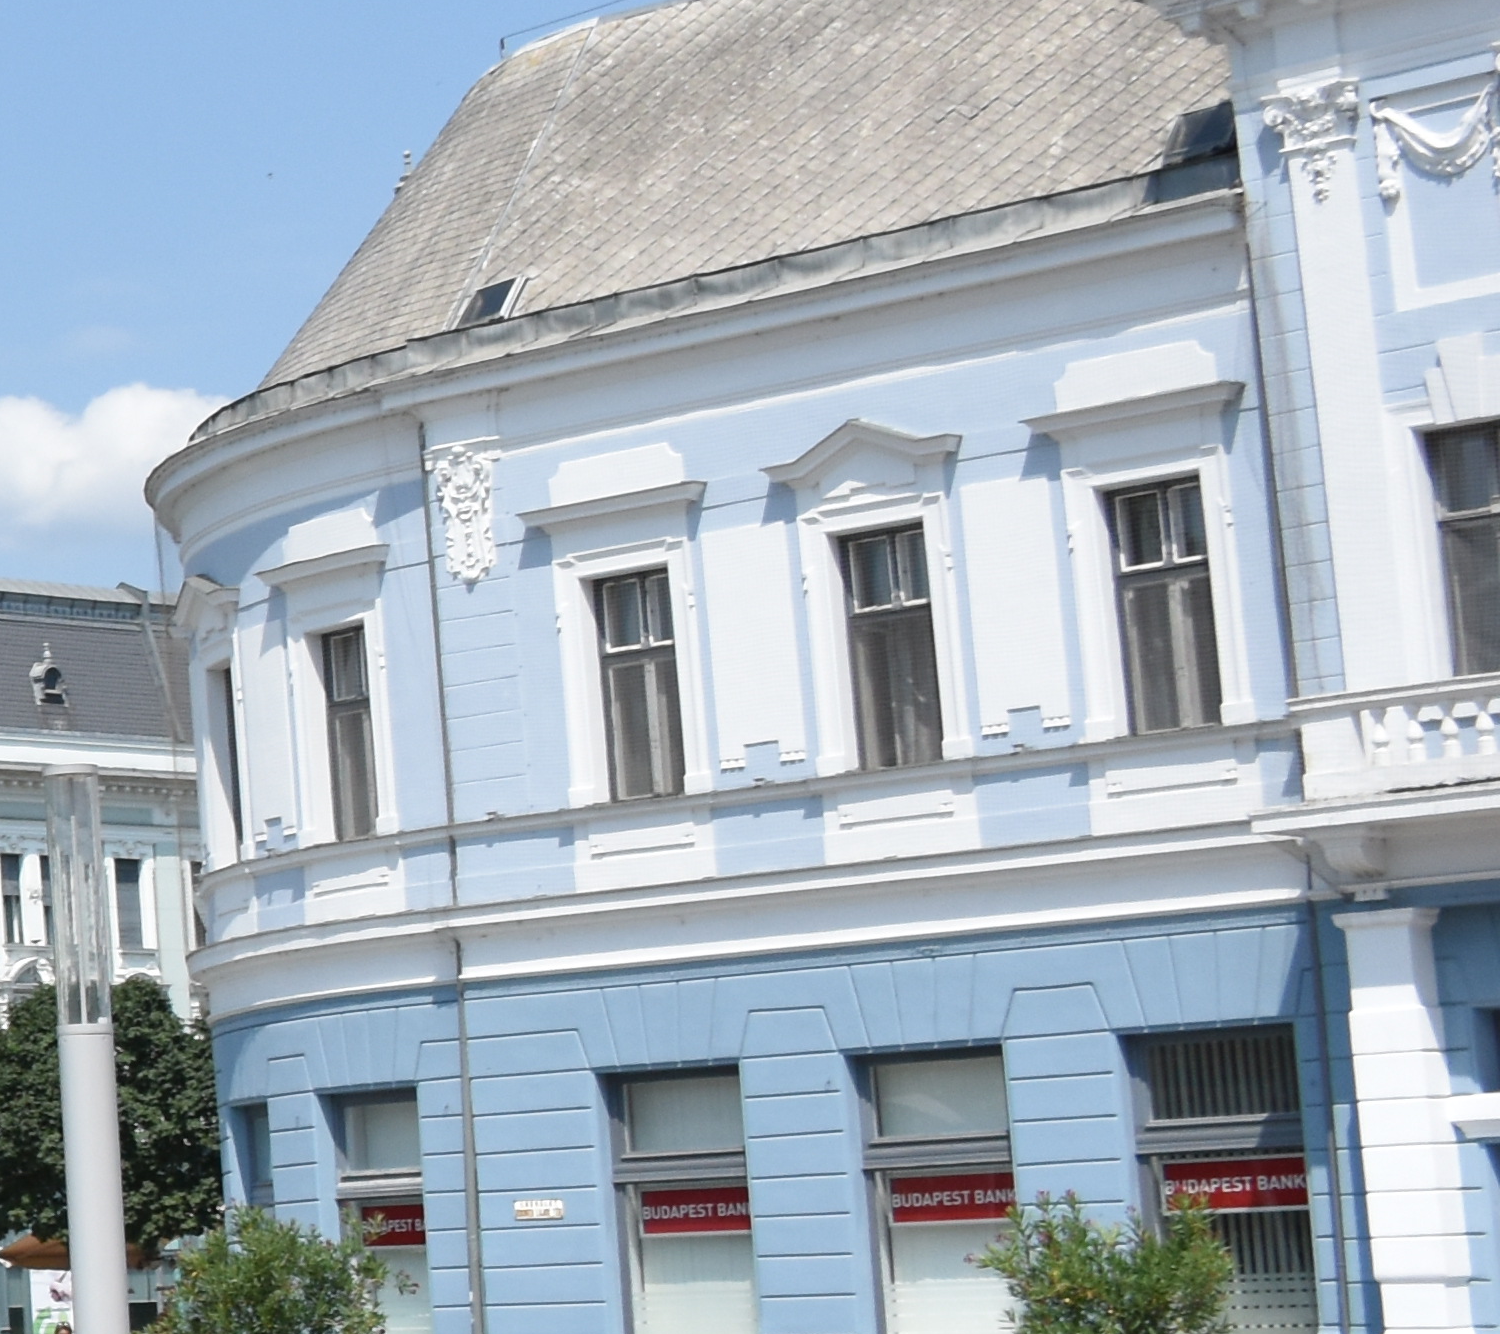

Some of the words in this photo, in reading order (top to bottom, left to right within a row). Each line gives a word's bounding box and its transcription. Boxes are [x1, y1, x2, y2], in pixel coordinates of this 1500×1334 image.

[1257, 1174, 1306, 1191] BANK
[892, 1190, 970, 1208] BUDAPEST
[643, 1203, 714, 1220] BUDAPEST
